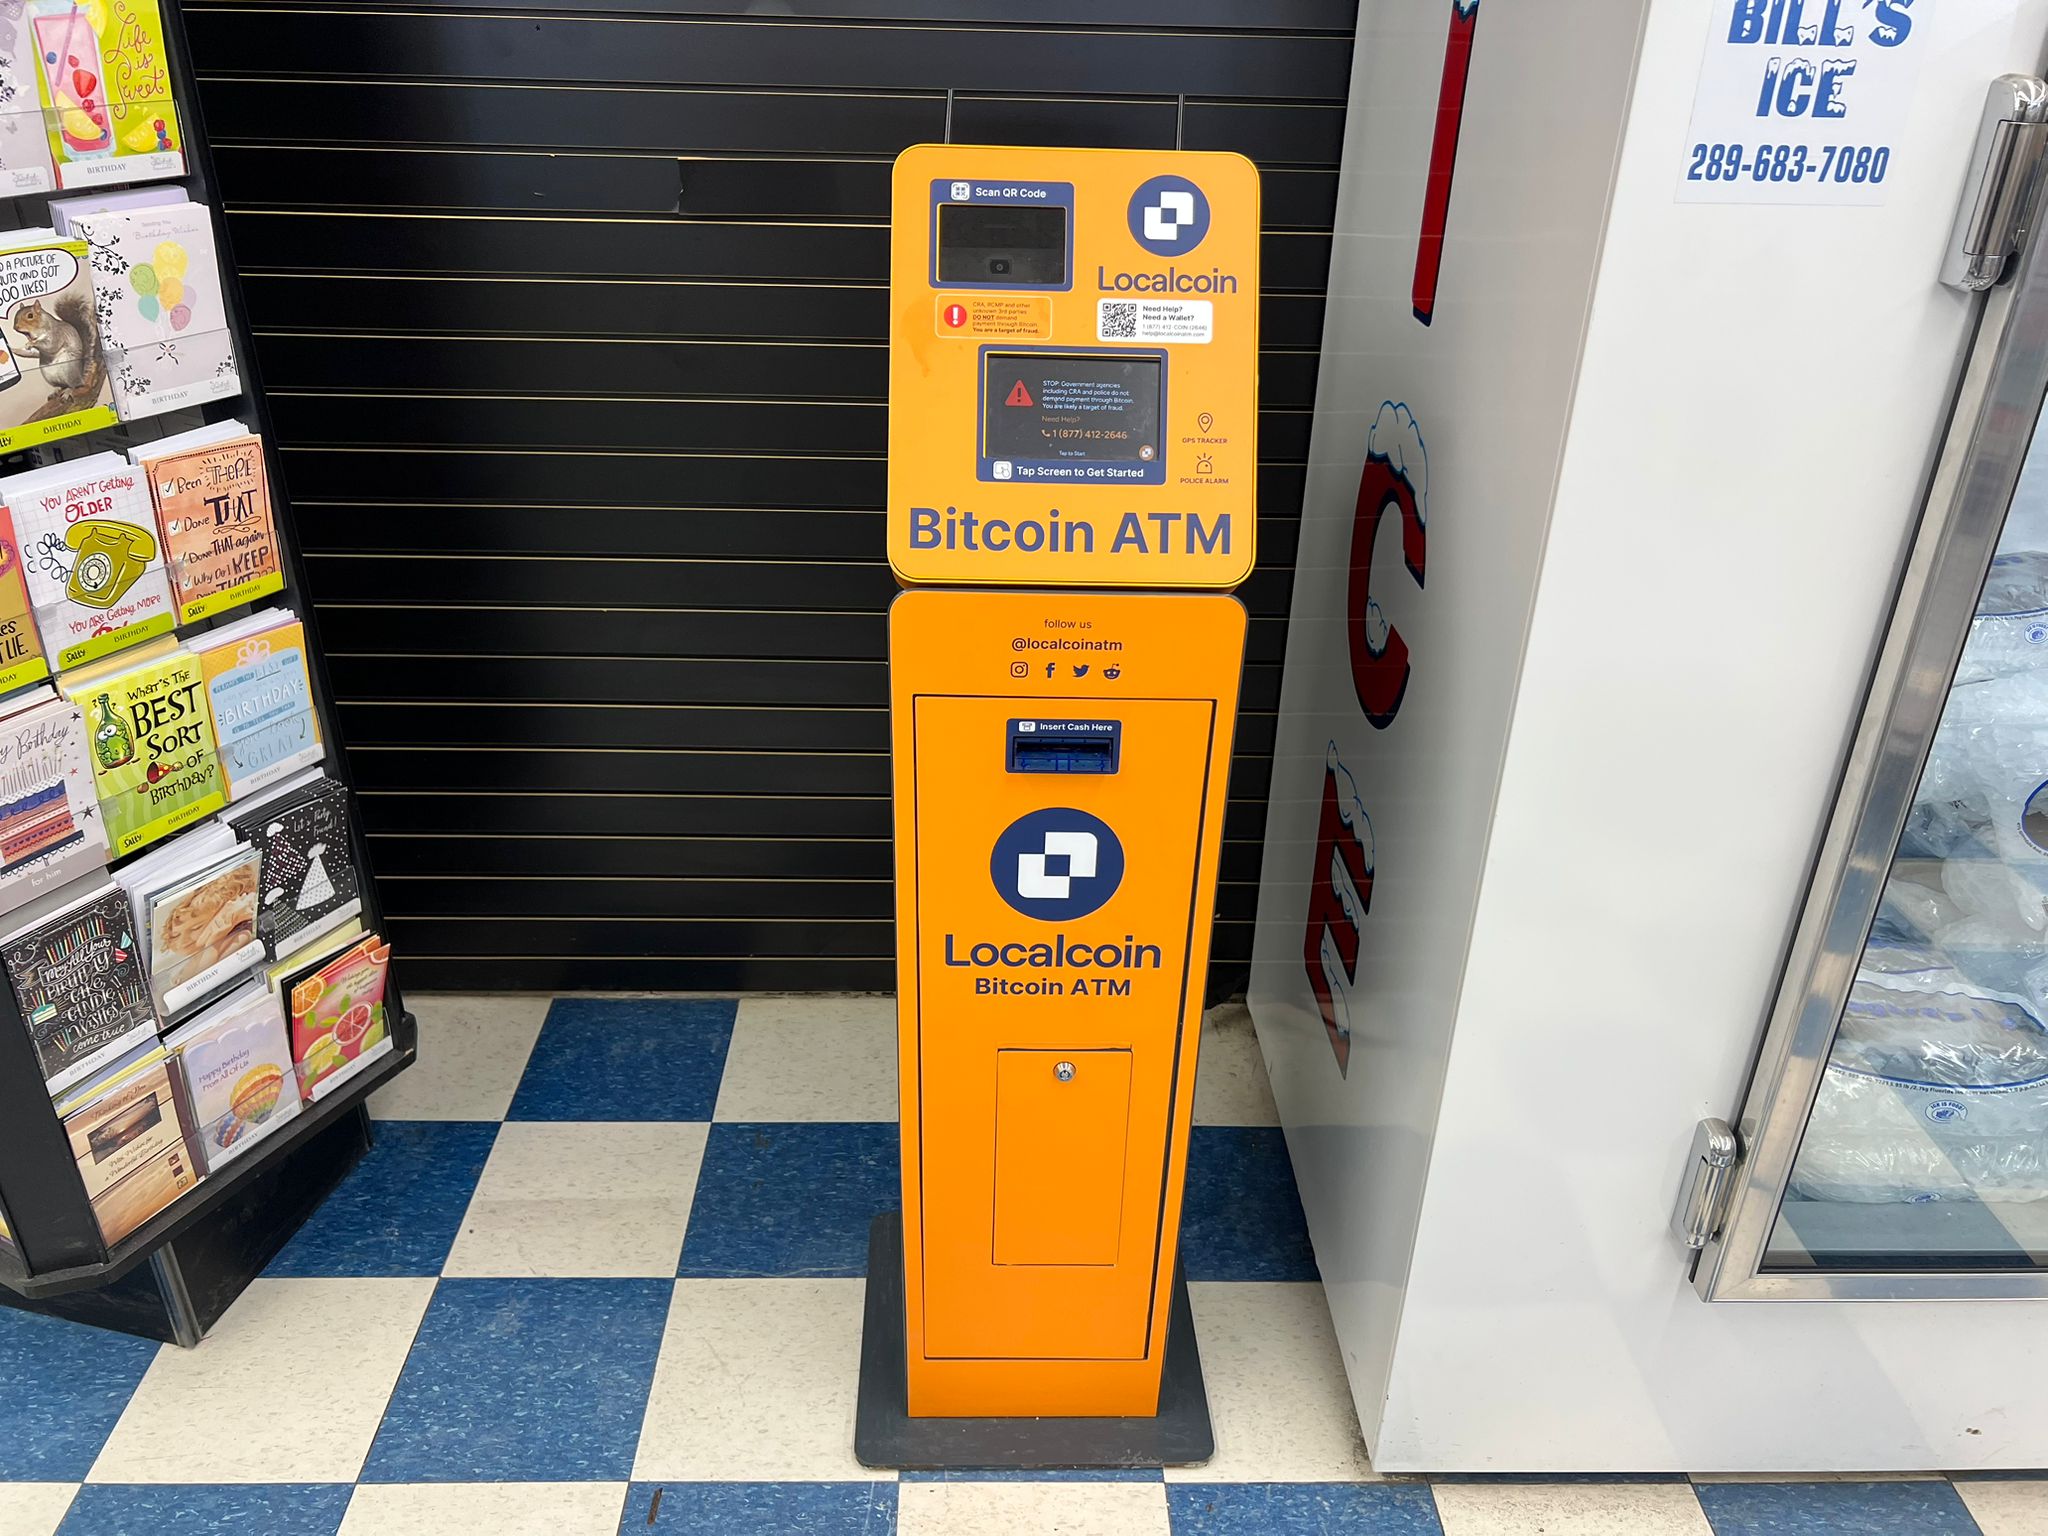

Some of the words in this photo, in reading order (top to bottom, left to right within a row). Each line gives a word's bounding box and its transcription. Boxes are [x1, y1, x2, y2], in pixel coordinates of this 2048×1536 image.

[104, 0, 151, 64] Life
[1727, 0, 1914, 47] BILL'S
[134, 53, 154, 69] is
[113, 62, 164, 119] Sweet
[1756, 57, 1857, 118] ICE
[87, 163, 127, 174] BIRTHDAY
[1687, 143, 1890, 184] 289-683-7080
[975, 187, 1000, 197] Scan
[1002, 187, 1017, 197] QR
[1020, 188, 1046, 198] Code
[14, 255, 44, 269] PICTURE
[46, 254, 56, 264] OF
[41, 265, 60, 278] GOT
[1098, 265, 1237, 294] Localcoin
[22, 280, 48, 296] LIKES!
[152, 391, 189, 404] BIRTHDAY
[43, 419, 82, 434] BIRTHDAY
[1059, 429, 1083, 438] (877)
[1085, 430, 1127, 439] 412-2646
[1017, 466, 1034, 476] Tap
[1037, 466, 1071, 476] Screen
[1074, 467, 1084, 476] to
[1087, 467, 1104, 476] Get
[1107, 467, 1144, 477] Started
[177, 476, 202, 494] Been
[40, 496, 62, 513] YOU
[65, 496, 113, 523] OLDER
[203, 489, 258, 527] THAT
[909, 506, 1094, 552] Bitcoin
[1110, 512, 1231, 554] ATM
[211, 535, 234, 556] THAT
[235, 529, 265, 550] again
[232, 545, 269, 575] KEEP
[230, 585, 261, 600] BIRTHDAY
[69, 620, 86, 634] YOU
[1044, 618, 1076, 629] follow
[1080, 621, 1092, 629] us
[113, 625, 149, 643] BIRTHDAY
[6, 633, 29, 660] LIE.
[1012, 637, 1123, 651] @localcoinatm
[130, 681, 202, 739] BEST
[224, 680, 299, 725] BIRTHDAY
[1040, 723, 1065, 731] Insert
[16, 722, 69, 760] Birthday
[146, 721, 203, 760] SORT
[186, 749, 205, 768] OF
[168, 806, 200, 825] BIRTHDAY
[31, 876, 44, 887] for
[46, 868, 62, 881] him
[945, 934, 1161, 968] Localcoin
[46, 952, 110, 999] BIRTHDAY
[186, 969, 219, 993] BIRTHDAY
[975, 977, 1063, 995] Bitcoin
[1070, 979, 1131, 996] ATM
[73, 1035, 99, 1053] come
[69, 1053, 105, 1076] BIRTHDAY
[199, 1066, 221, 1083] Happy
[222, 1049, 249, 1069] Birthday
[203, 1078, 219, 1091] From
[220, 1071, 228, 1081] All
